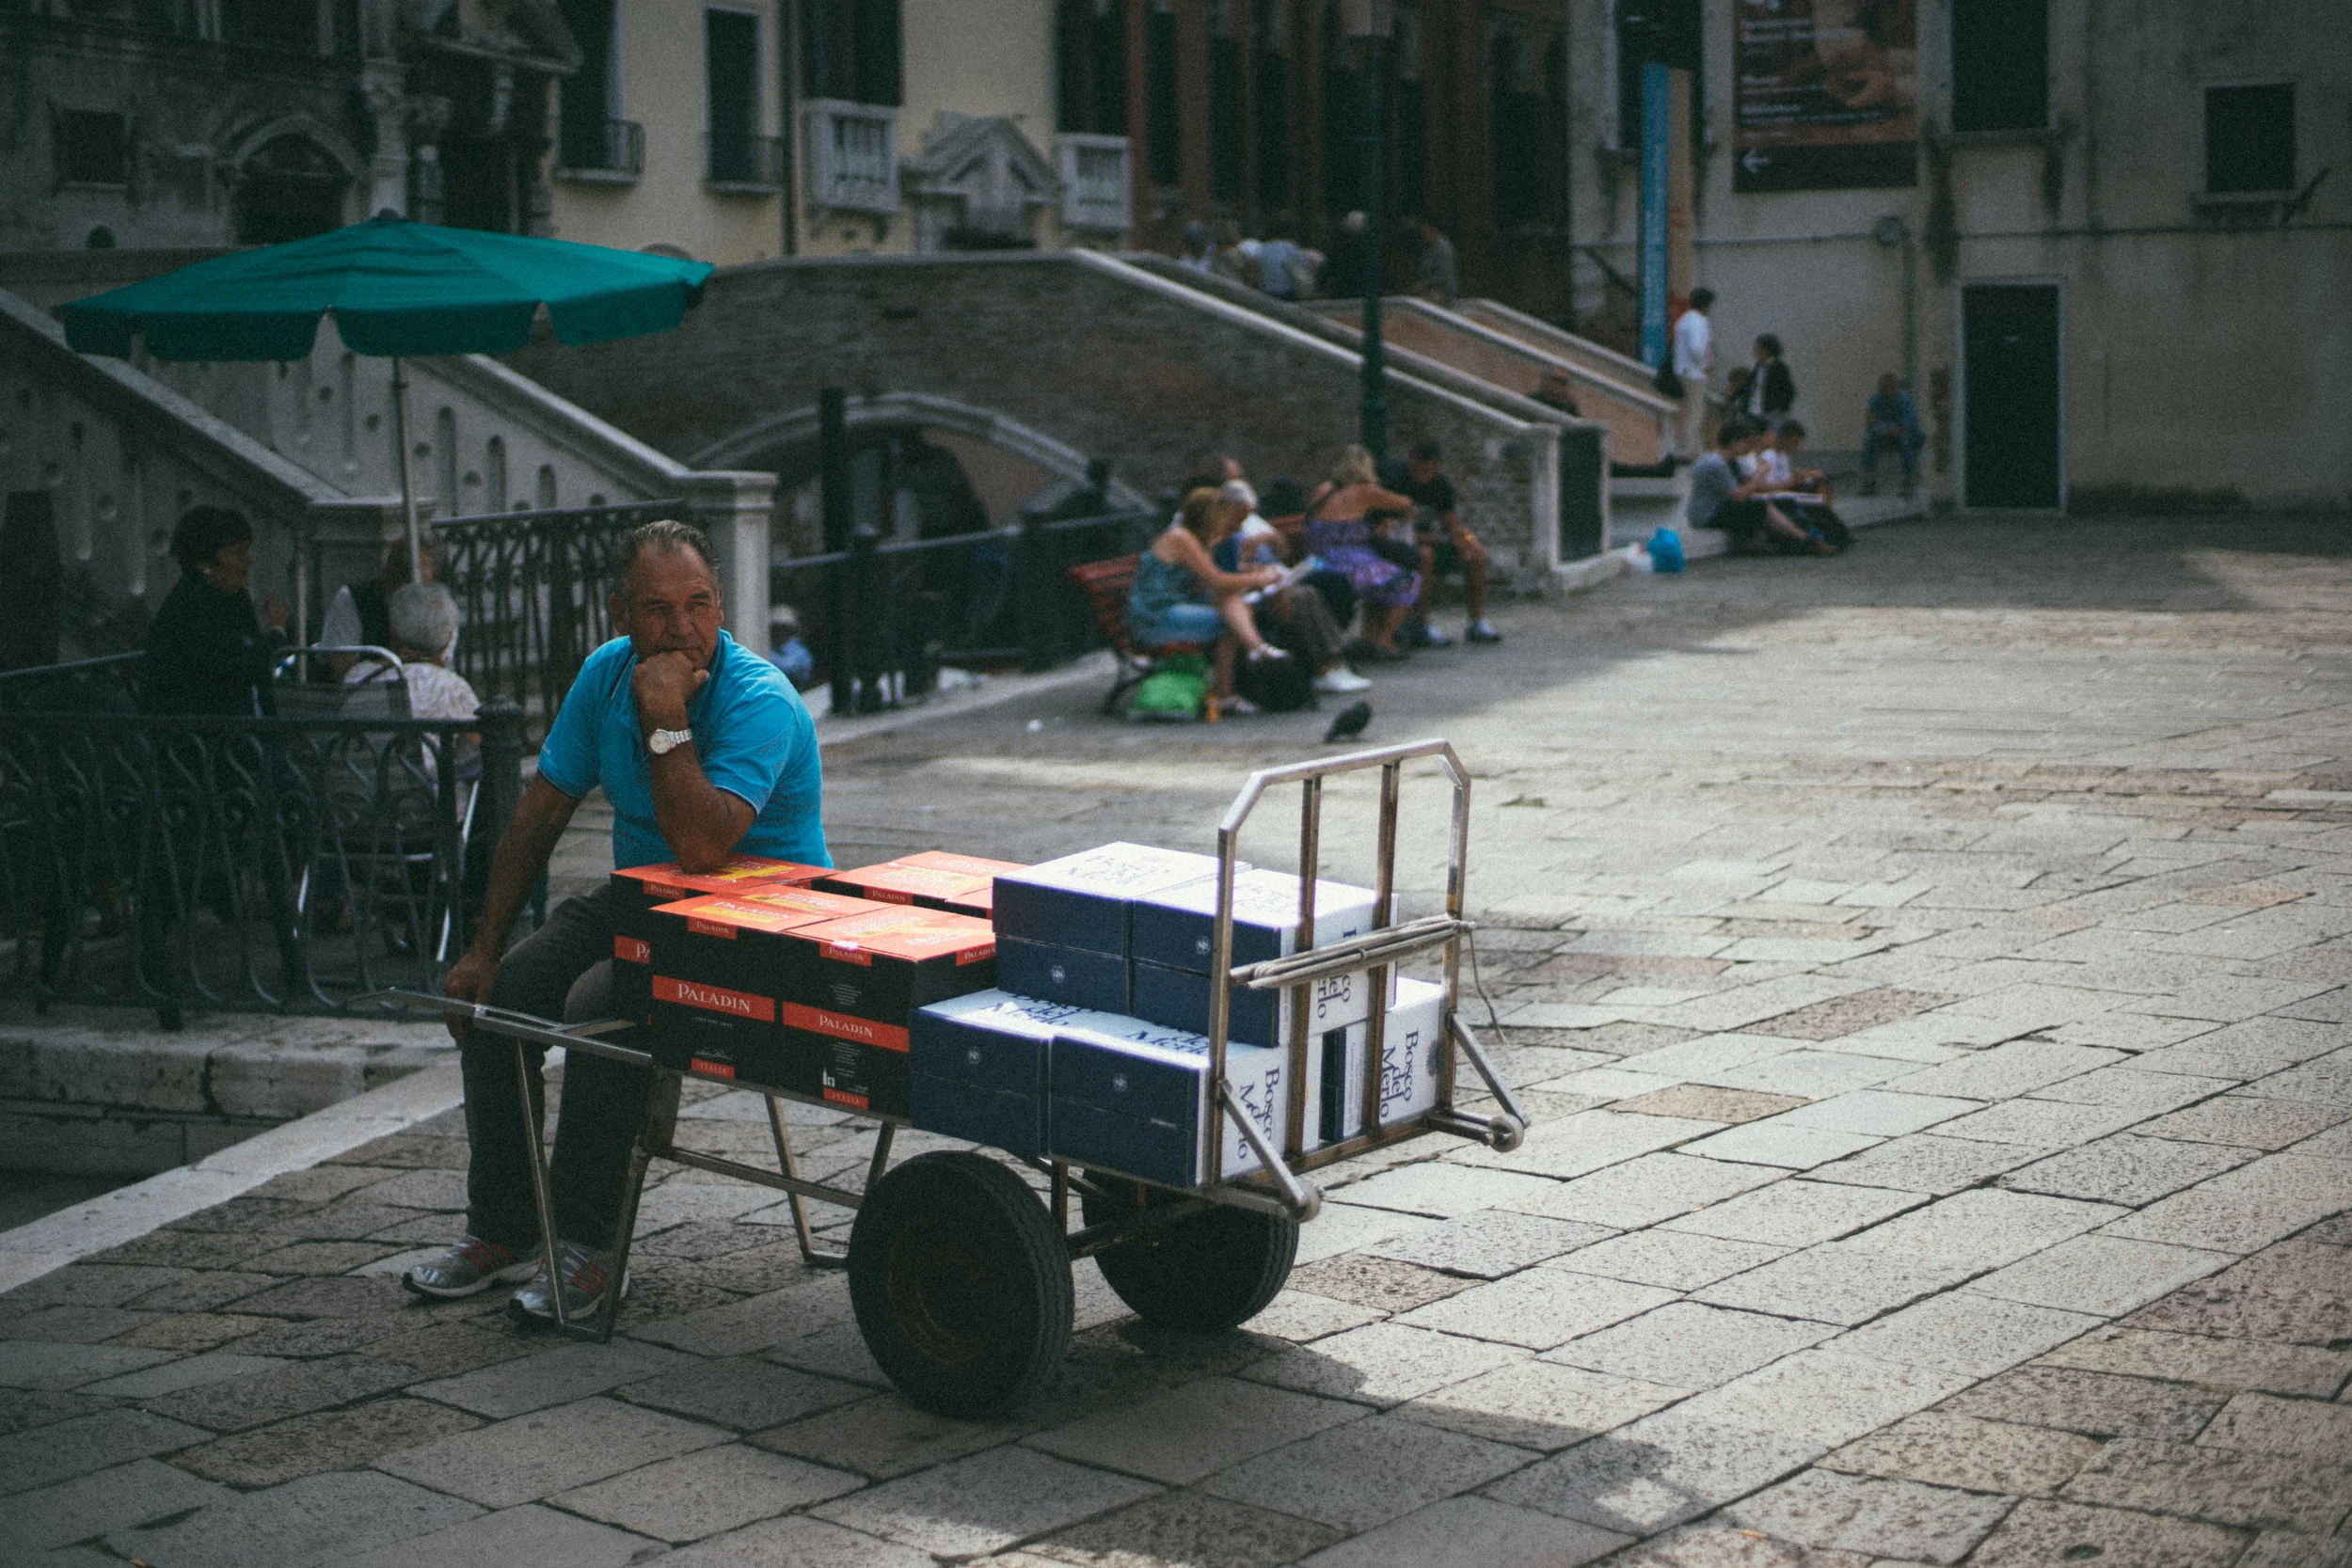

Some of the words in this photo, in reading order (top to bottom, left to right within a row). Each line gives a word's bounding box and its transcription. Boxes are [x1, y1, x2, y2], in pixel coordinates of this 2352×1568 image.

[650, 884, 679, 896] PALADIN
[872, 890, 906, 902] PALADIN
[696, 921, 730, 934] PALADIN
[829, 946, 865, 961] PALADIN
[964, 946, 996, 959] PALADIN
[678, 983, 750, 1013] PALADIN
[1317, 978, 1331, 1019] rlo
[819, 1014, 873, 1037] PALADIN
[700, 1062, 727, 1075] ITALIA
[1404, 1027, 1419, 1101] Bosco
[1380, 1044, 1396, 1117] Merlo
[1392, 1067, 1406, 1096] del
